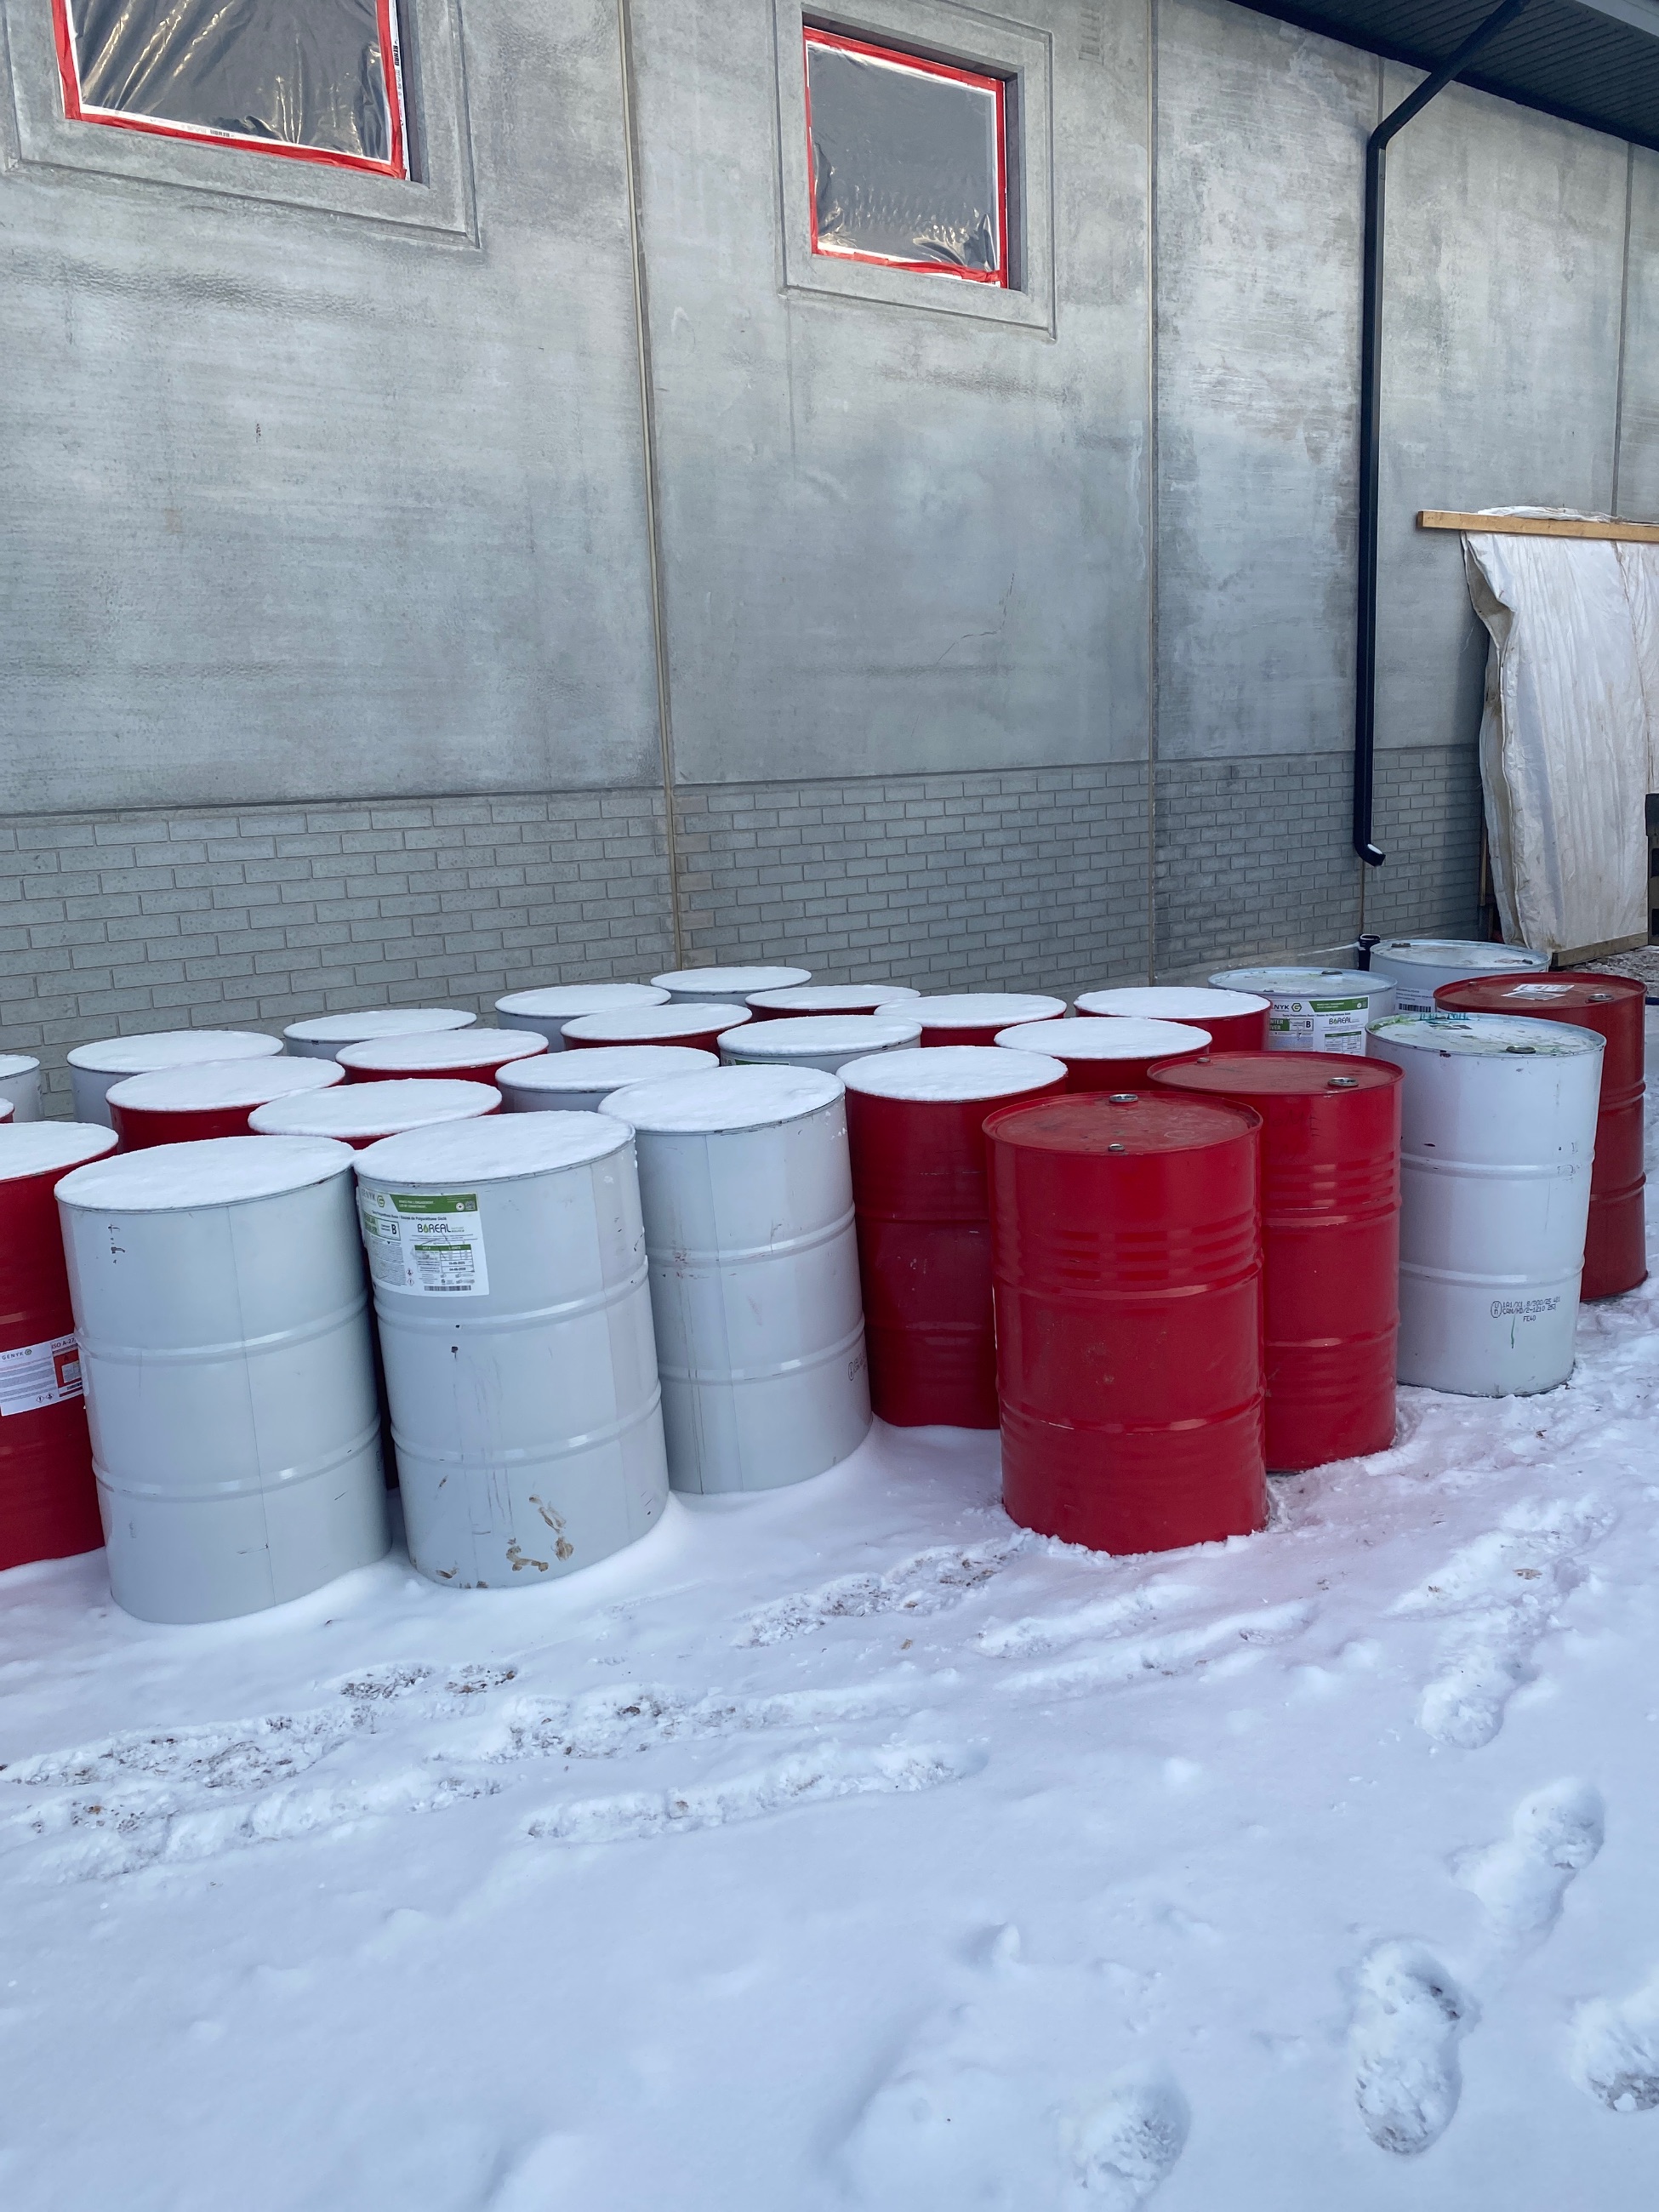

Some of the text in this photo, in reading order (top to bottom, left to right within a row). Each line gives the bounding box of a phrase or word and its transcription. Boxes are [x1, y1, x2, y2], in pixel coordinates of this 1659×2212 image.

[391, 1224, 396, 1234] B
[418, 1223, 451, 1233] BOREAL
[2, 1351, 24, 1360] GENYK
